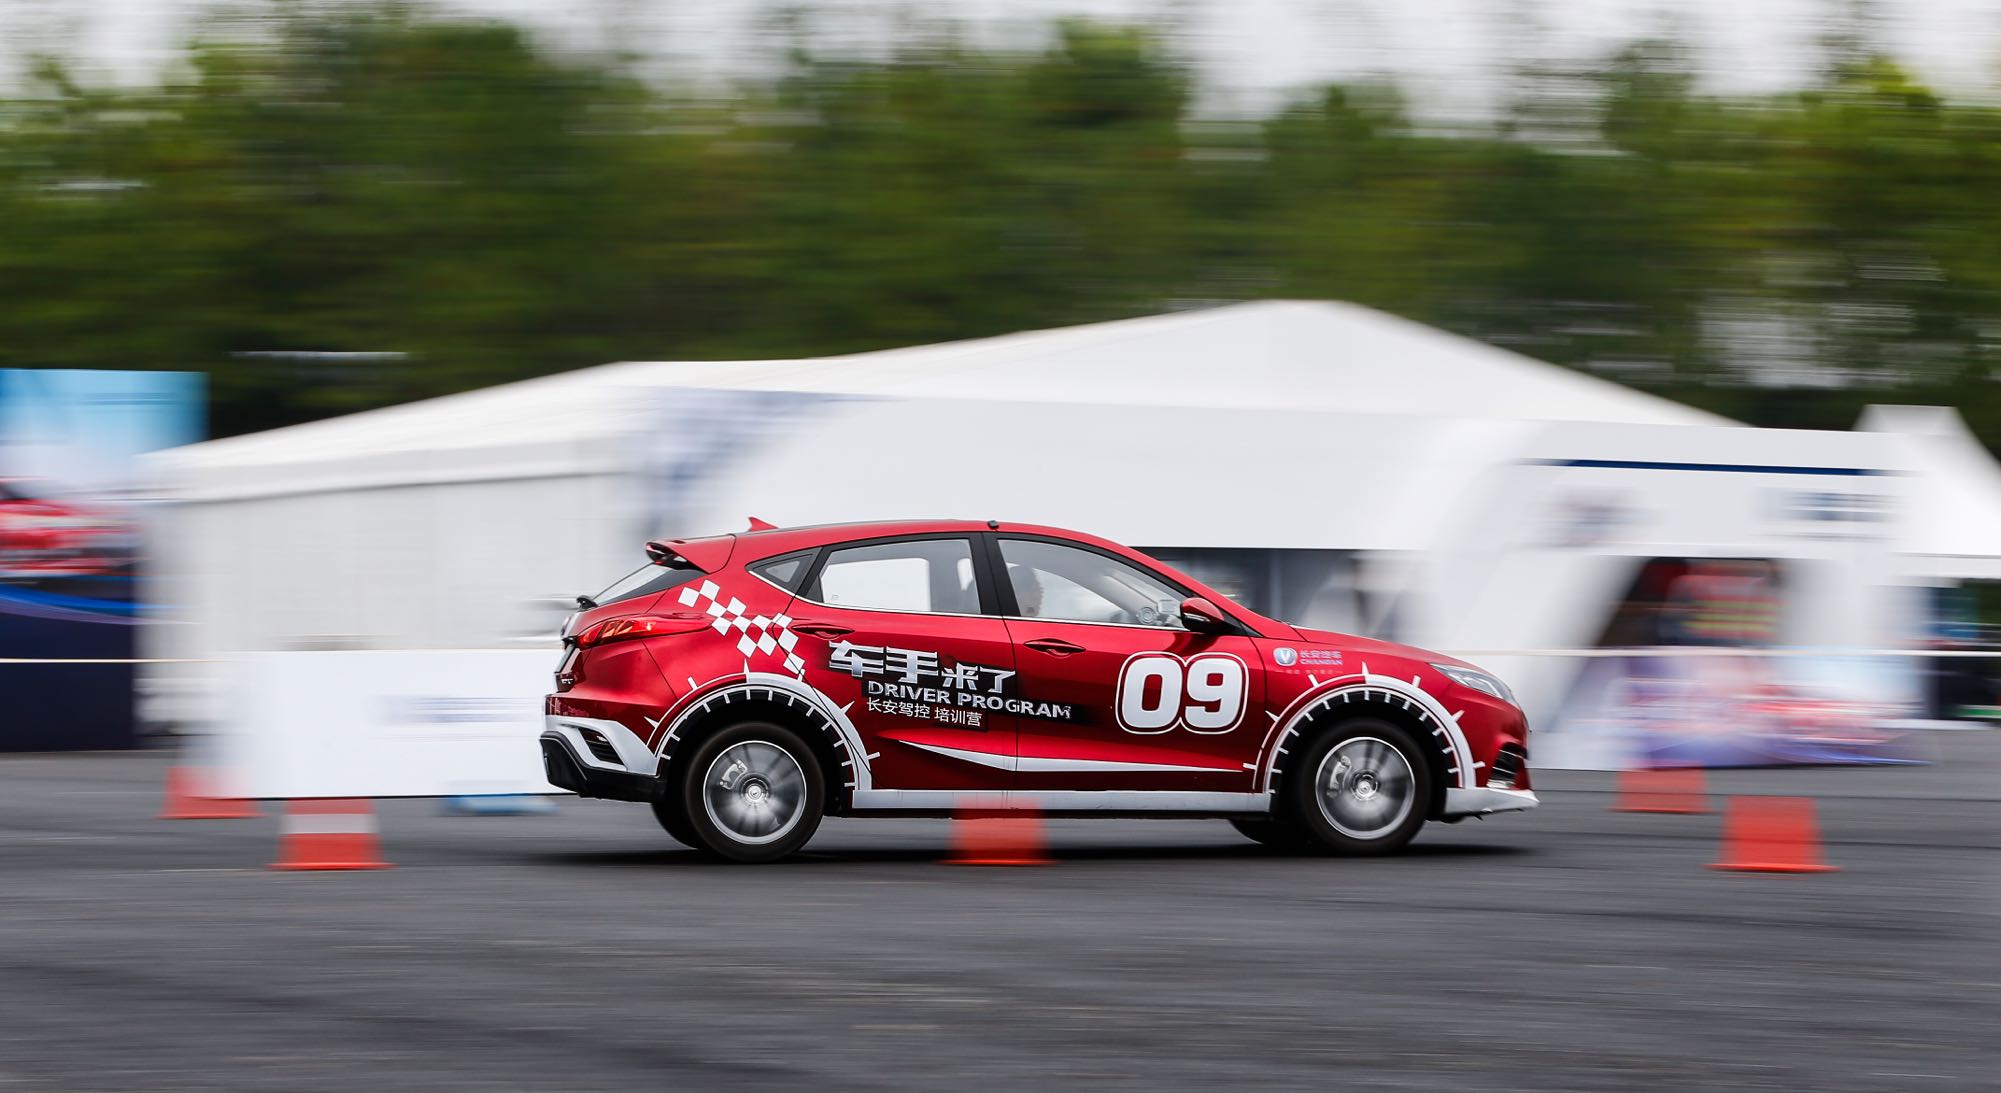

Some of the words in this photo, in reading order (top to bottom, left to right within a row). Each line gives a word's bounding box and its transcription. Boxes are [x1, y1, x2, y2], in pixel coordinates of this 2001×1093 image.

[829, 639, 1016, 693] 车手来了
[866, 697, 931, 719] 长安驾控
[934, 706, 983, 727] 培训营
[868, 680, 950, 704] DRIVER
[957, 692, 1072, 719] PROGRAM
[1115, 651, 1250, 735] 09
